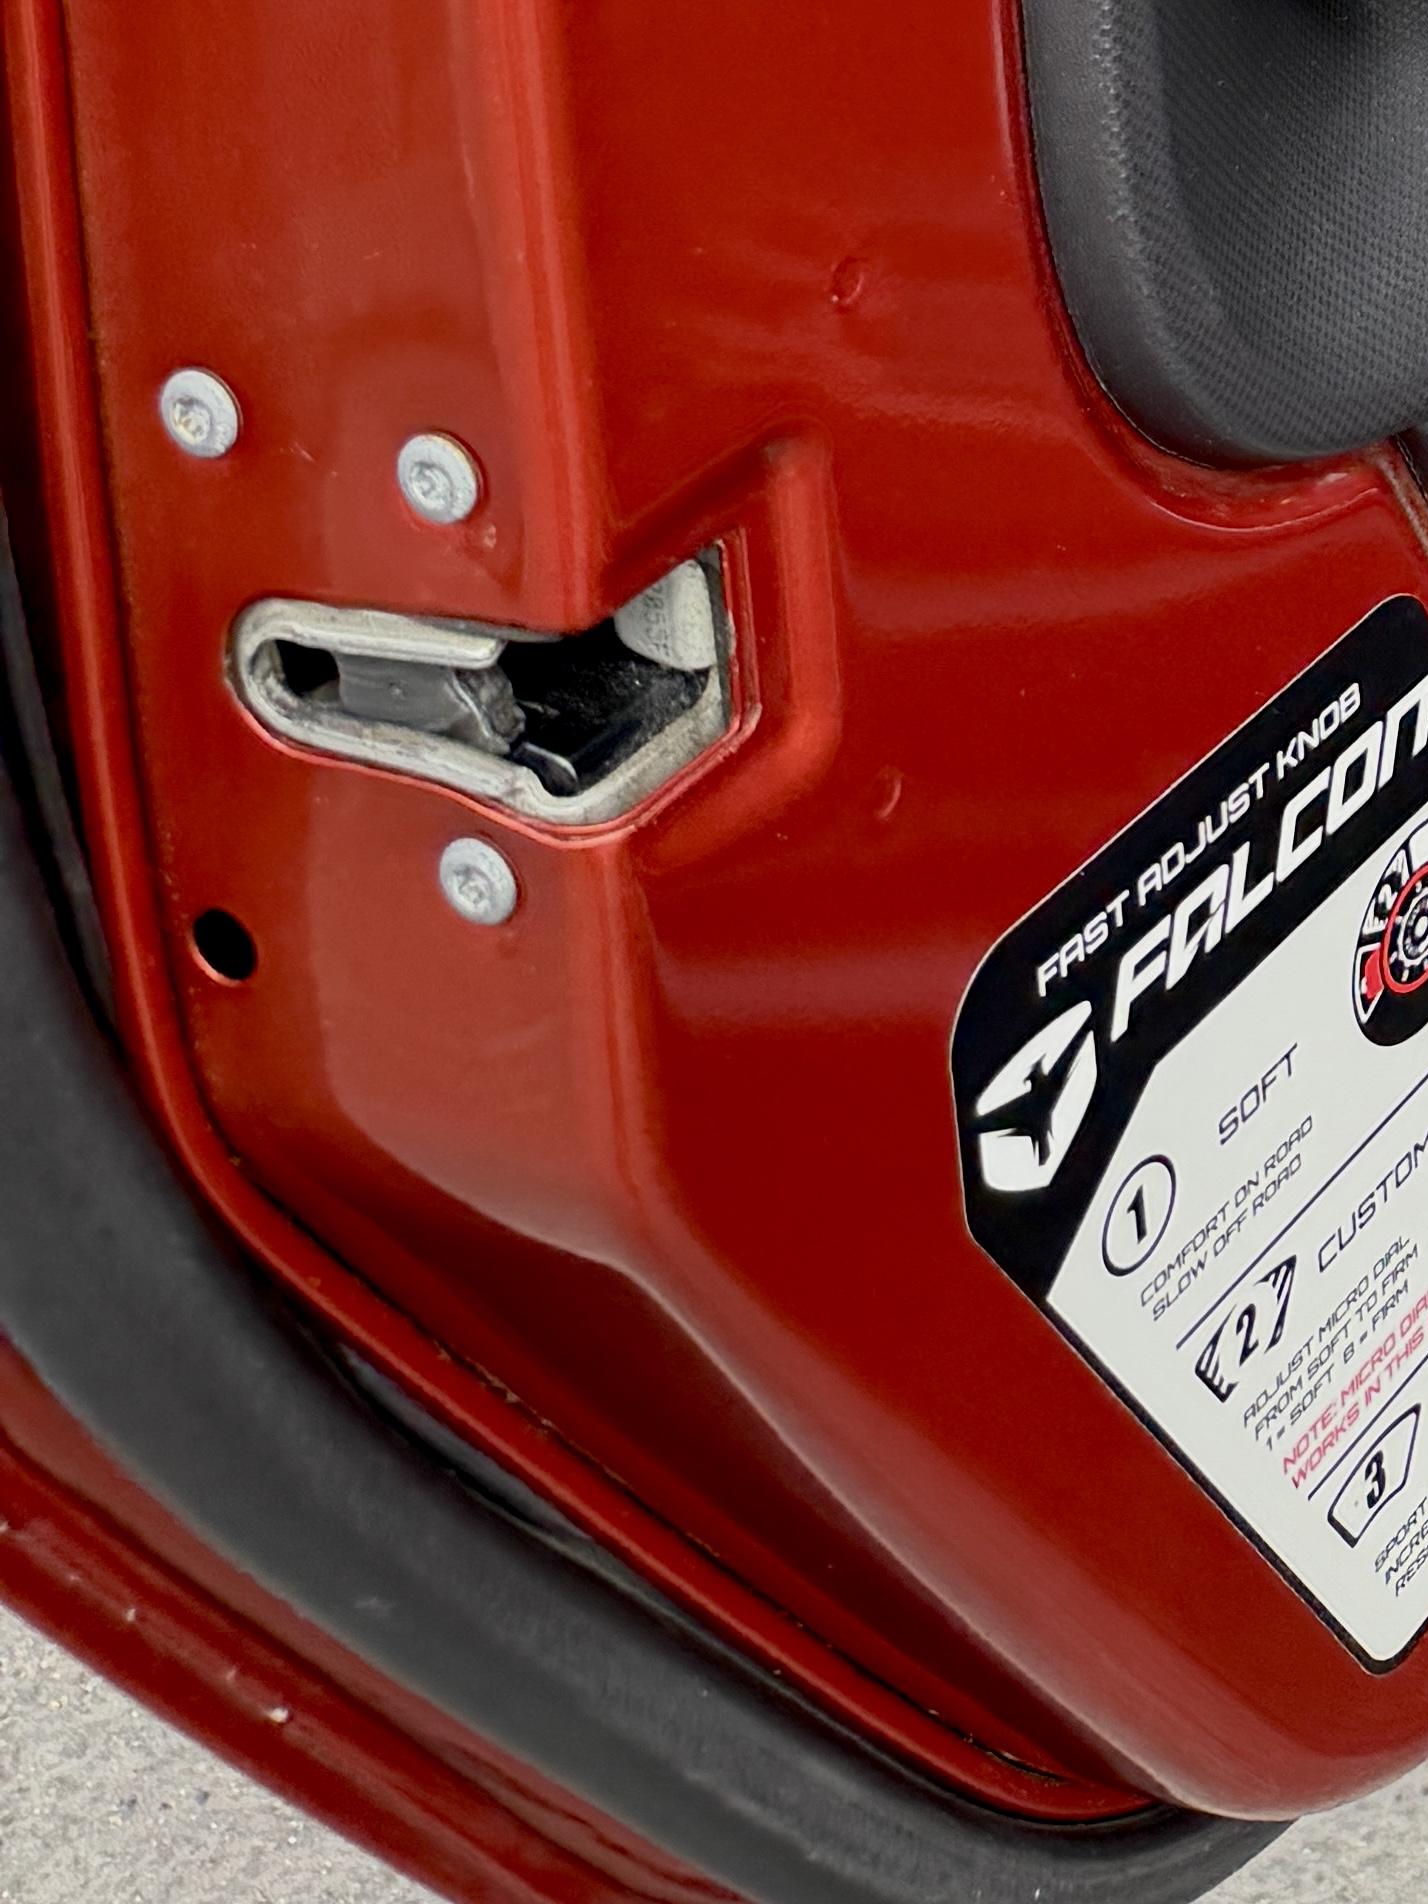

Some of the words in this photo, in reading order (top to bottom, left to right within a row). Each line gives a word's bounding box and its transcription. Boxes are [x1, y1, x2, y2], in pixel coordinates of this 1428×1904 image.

[1037, 890, 1129, 997] FAST
[1137, 762, 1270, 907] ADJUST
[1276, 682, 1362, 781] KNOB
[1218, 1042, 1298, 1145] SOFT
[1126, 1184, 1148, 1245] 1
[1140, 1202, 1230, 1307] COMFORT
[1234, 1171, 1260, 1208] ON
[1264, 1115, 1313, 1178] ROAD
[1153, 1254, 1208, 1322] SLOW
[1213, 1208, 1249, 1259] OFF
[1252, 1153, 1302, 1218] ROAD
[1235, 1303, 1260, 1367] 2
[1243, 1336, 1314, 1428] ADJUST
[1318, 1275, 1369, 1343] MICRO
[1372, 1235, 1411, 1282] DIAL
[1255, 1374, 1304, 1442] FROM
[1307, 1319, 1351, 1372] SOFT
[1355, 1293, 1379, 1323] TO
[1381, 1243, 1418, 1296] FIRM
[1282, 1398, 1338, 1475] NOTE:
[1340, 1331, 1397, 1407] MICRO
[1289, 1363, 1336, 1427] SOFT
[1372, 1279, 1409, 1335] FIRM
[1291, 1401, 1361, 1489] WORKS
[1364, 1375, 1383, 1405] IN
[1385, 1325, 1426, 1380] THIS
[1363, 1449, 1387, 1510] 3
[1374, 1495, 1428, 1573] SPORT
